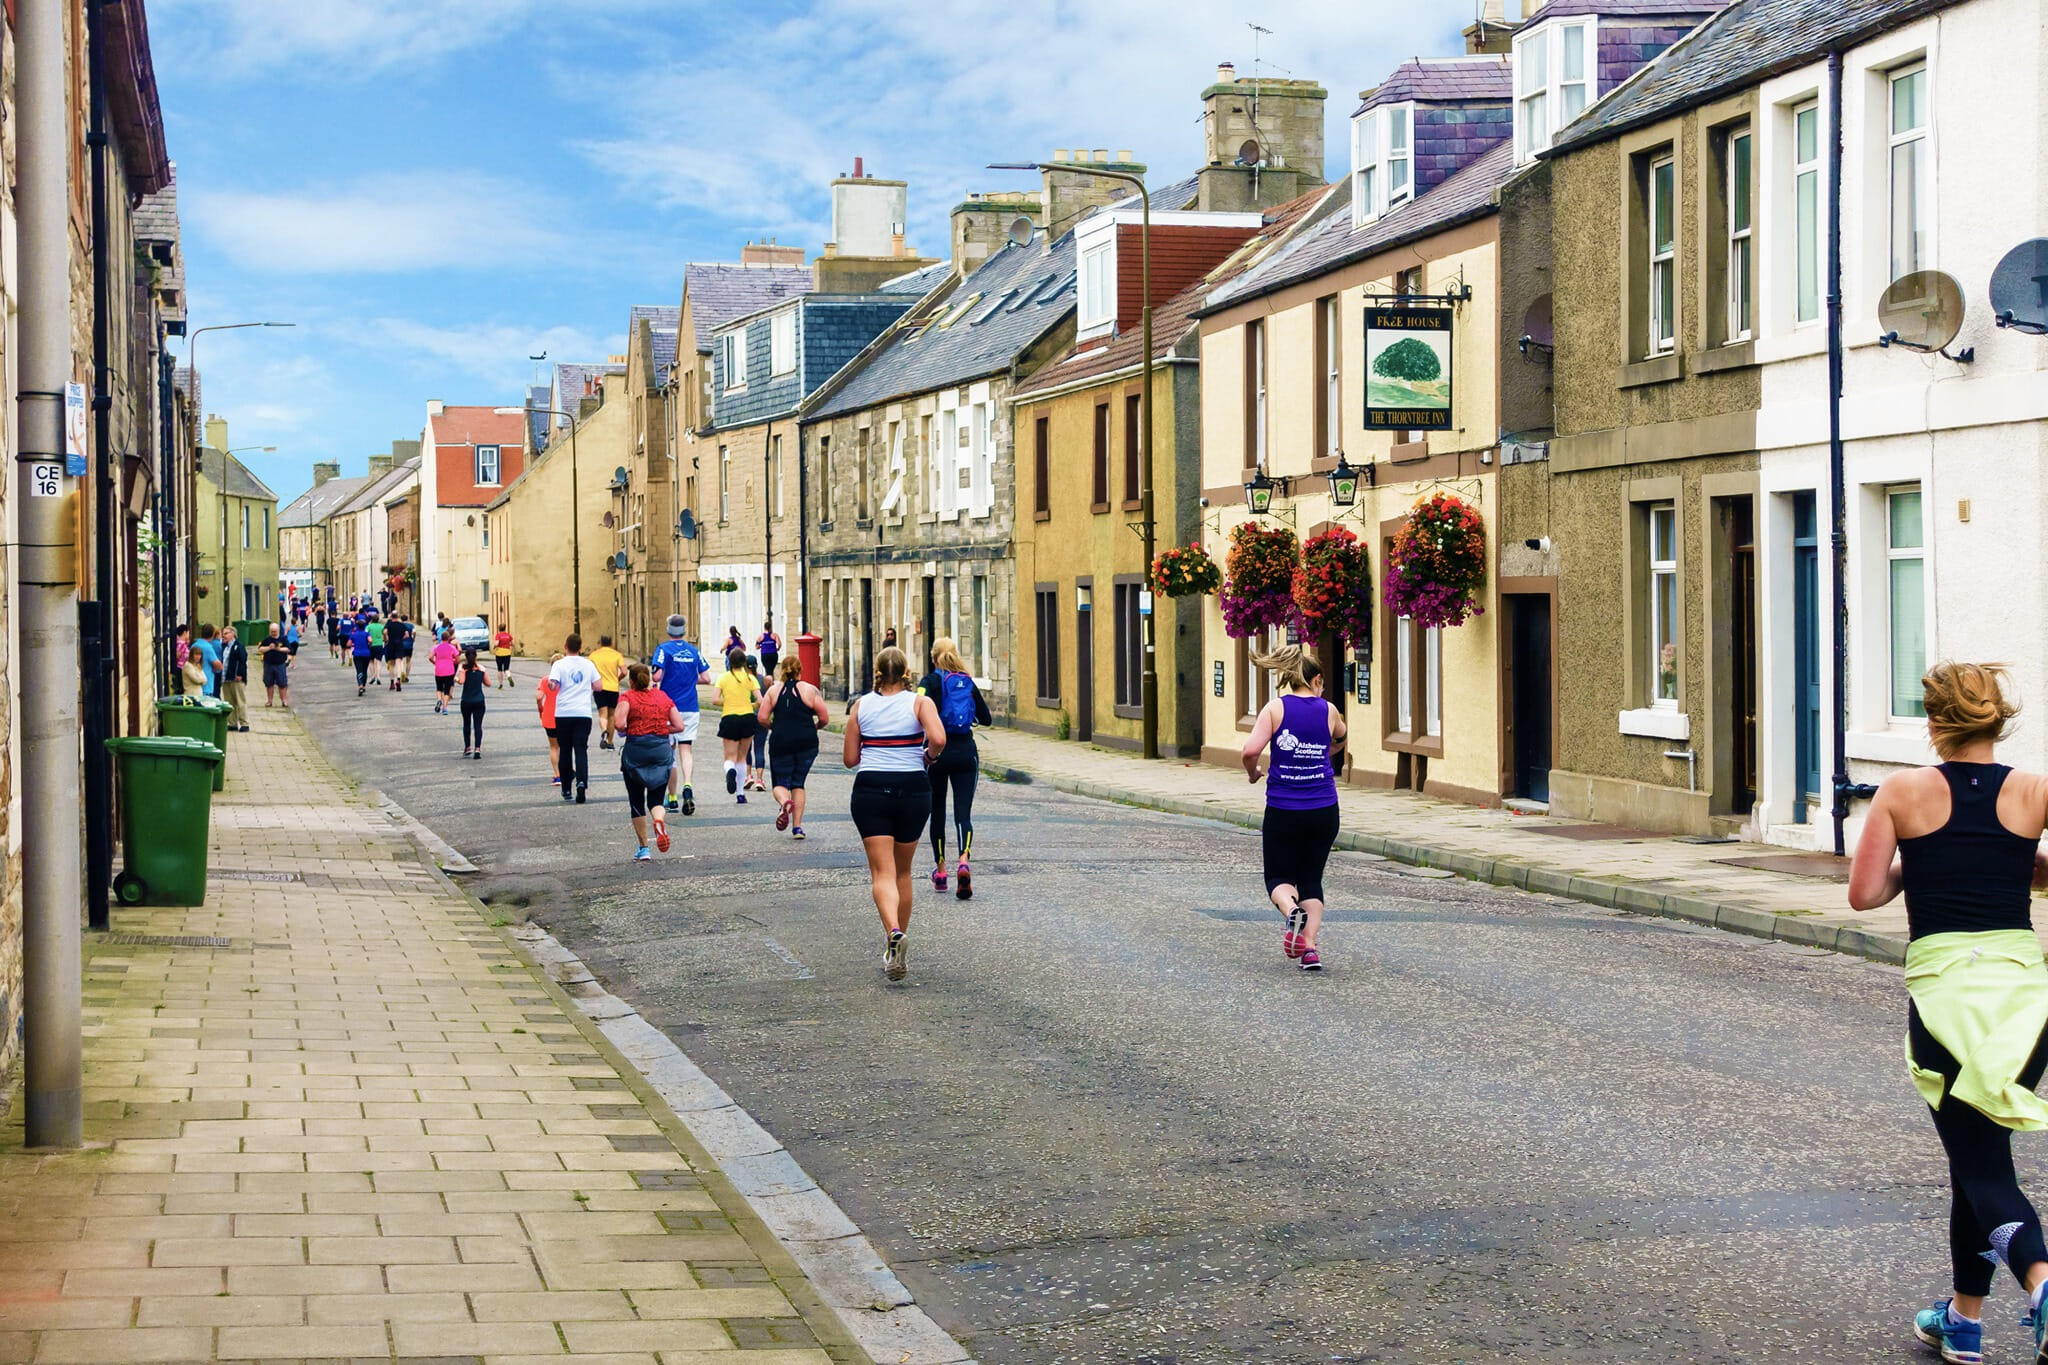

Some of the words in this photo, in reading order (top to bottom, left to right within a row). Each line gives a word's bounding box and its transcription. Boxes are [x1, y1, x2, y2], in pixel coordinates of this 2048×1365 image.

[1407, 317, 1441, 328] HOUSE
[1370, 411, 1385, 425] THE
[1388, 411, 1431, 425] THORNTREE
[1432, 411, 1446, 425] INN
[36, 466, 59, 480] CE
[38, 481, 57, 495] 16
[1295, 747, 1322, 755] Scotland
